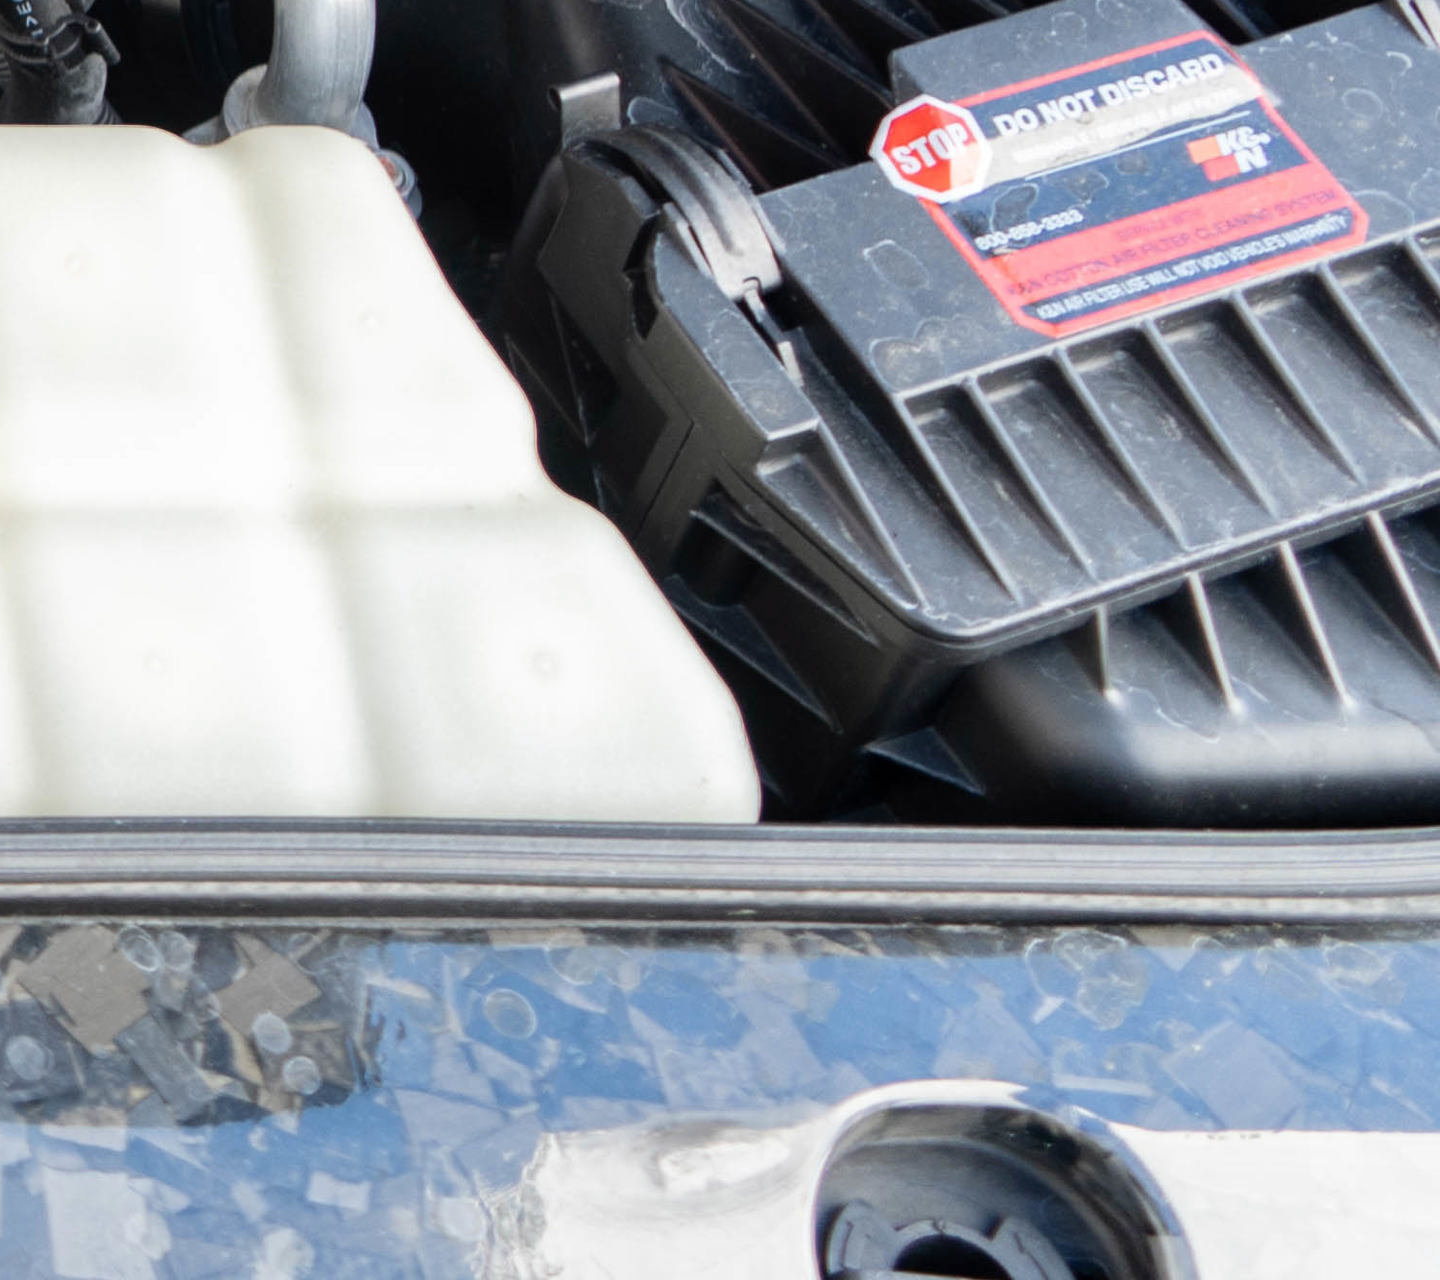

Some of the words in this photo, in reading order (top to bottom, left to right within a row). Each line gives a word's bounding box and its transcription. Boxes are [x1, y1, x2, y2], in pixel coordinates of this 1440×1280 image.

[993, 108, 1035, 138] DO
[1049, 89, 1098, 124] NOT
[1107, 53, 1224, 105] DISCARD
[891, 122, 972, 175] STOP
[1274, 187, 1336, 217] SYSTEM
[1084, 282, 1124, 307] FILTER
[1121, 274, 1149, 295] USE
[1146, 266, 1177, 288] WILL
[1173, 258, 1200, 280] NOT
[1200, 250, 1229, 271] VOID
[1284, 212, 1347, 245] WARRANTY
